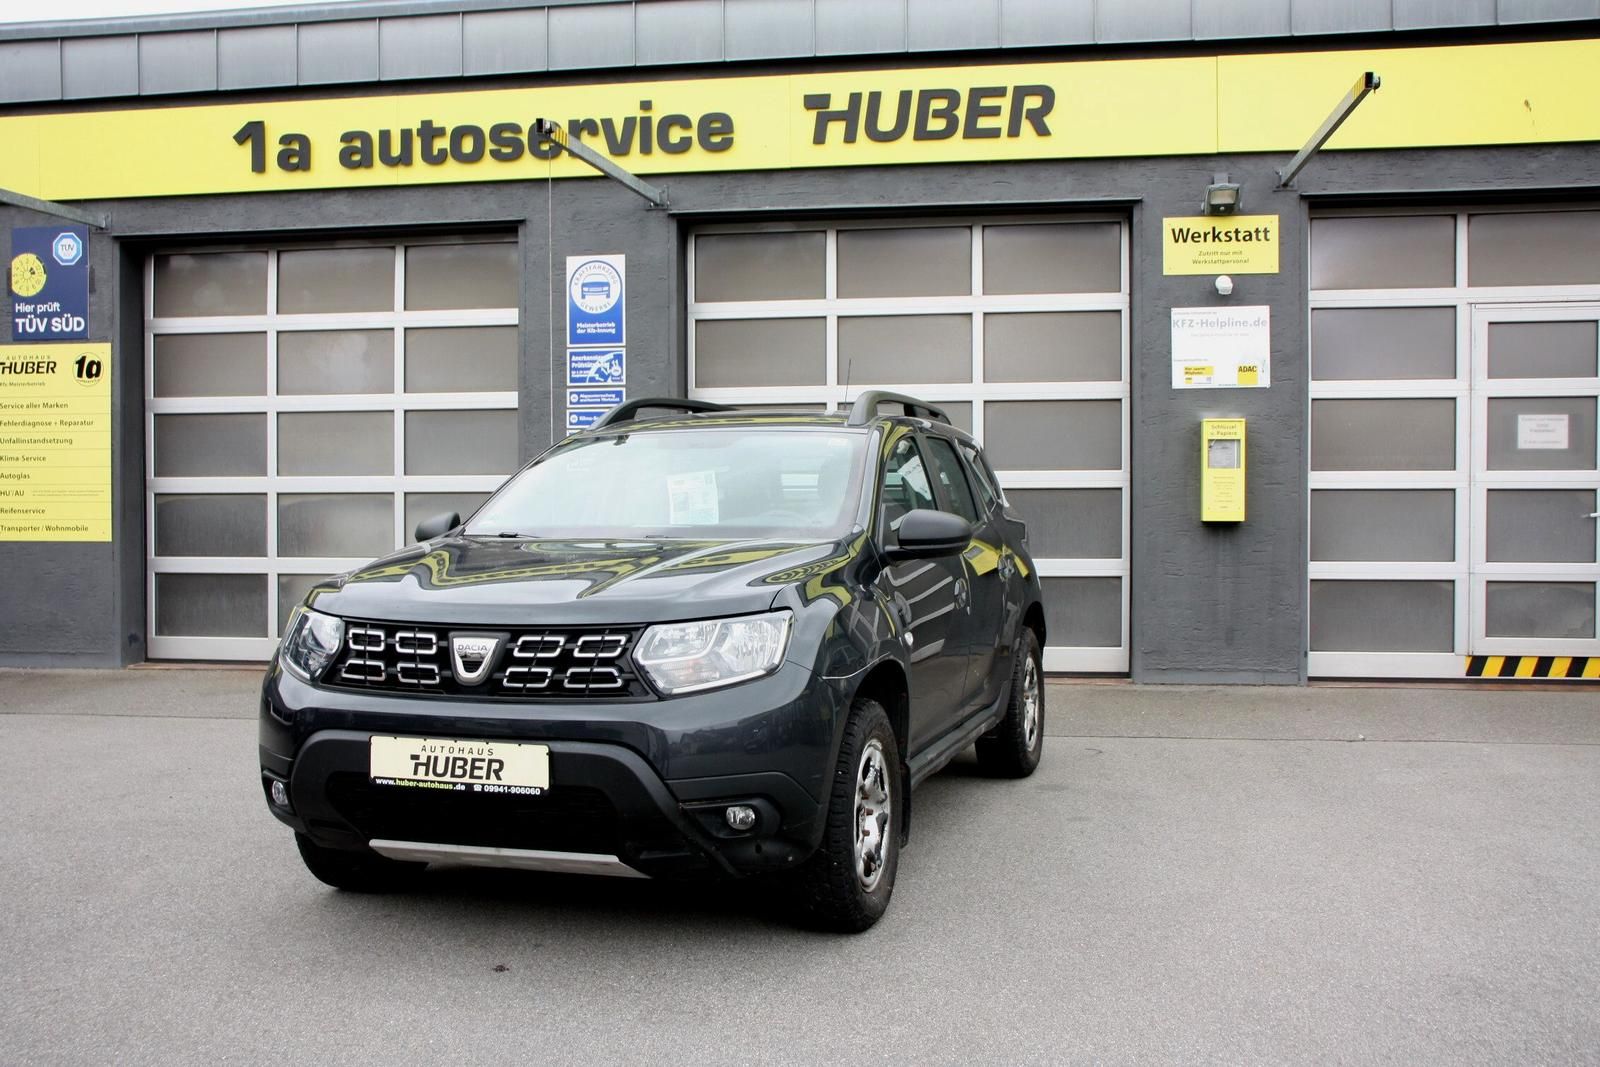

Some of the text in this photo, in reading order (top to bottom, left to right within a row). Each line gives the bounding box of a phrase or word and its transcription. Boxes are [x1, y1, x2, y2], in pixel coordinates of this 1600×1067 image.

[232, 84, 1056, 173] 1a autoservice HUBER
[1171, 226, 1270, 243] Werkstatt
[15, 302, 60, 314] Hier prüft
[15, 313, 85, 333] TÜV SÜD
[0, 361, 57, 374] HUBER
[75, 355, 102, 379] 1a
[0, 420, 52, 428] Fehlerdiagnose
[59, 419, 94, 427] Reparatur
[0, 472, 30, 480] Autoglas
[420, 744, 494, 756] AUTOHAUS
[410, 754, 505, 781] HUBER
[375, 778, 465, 791] www.huber-autohaus.de
